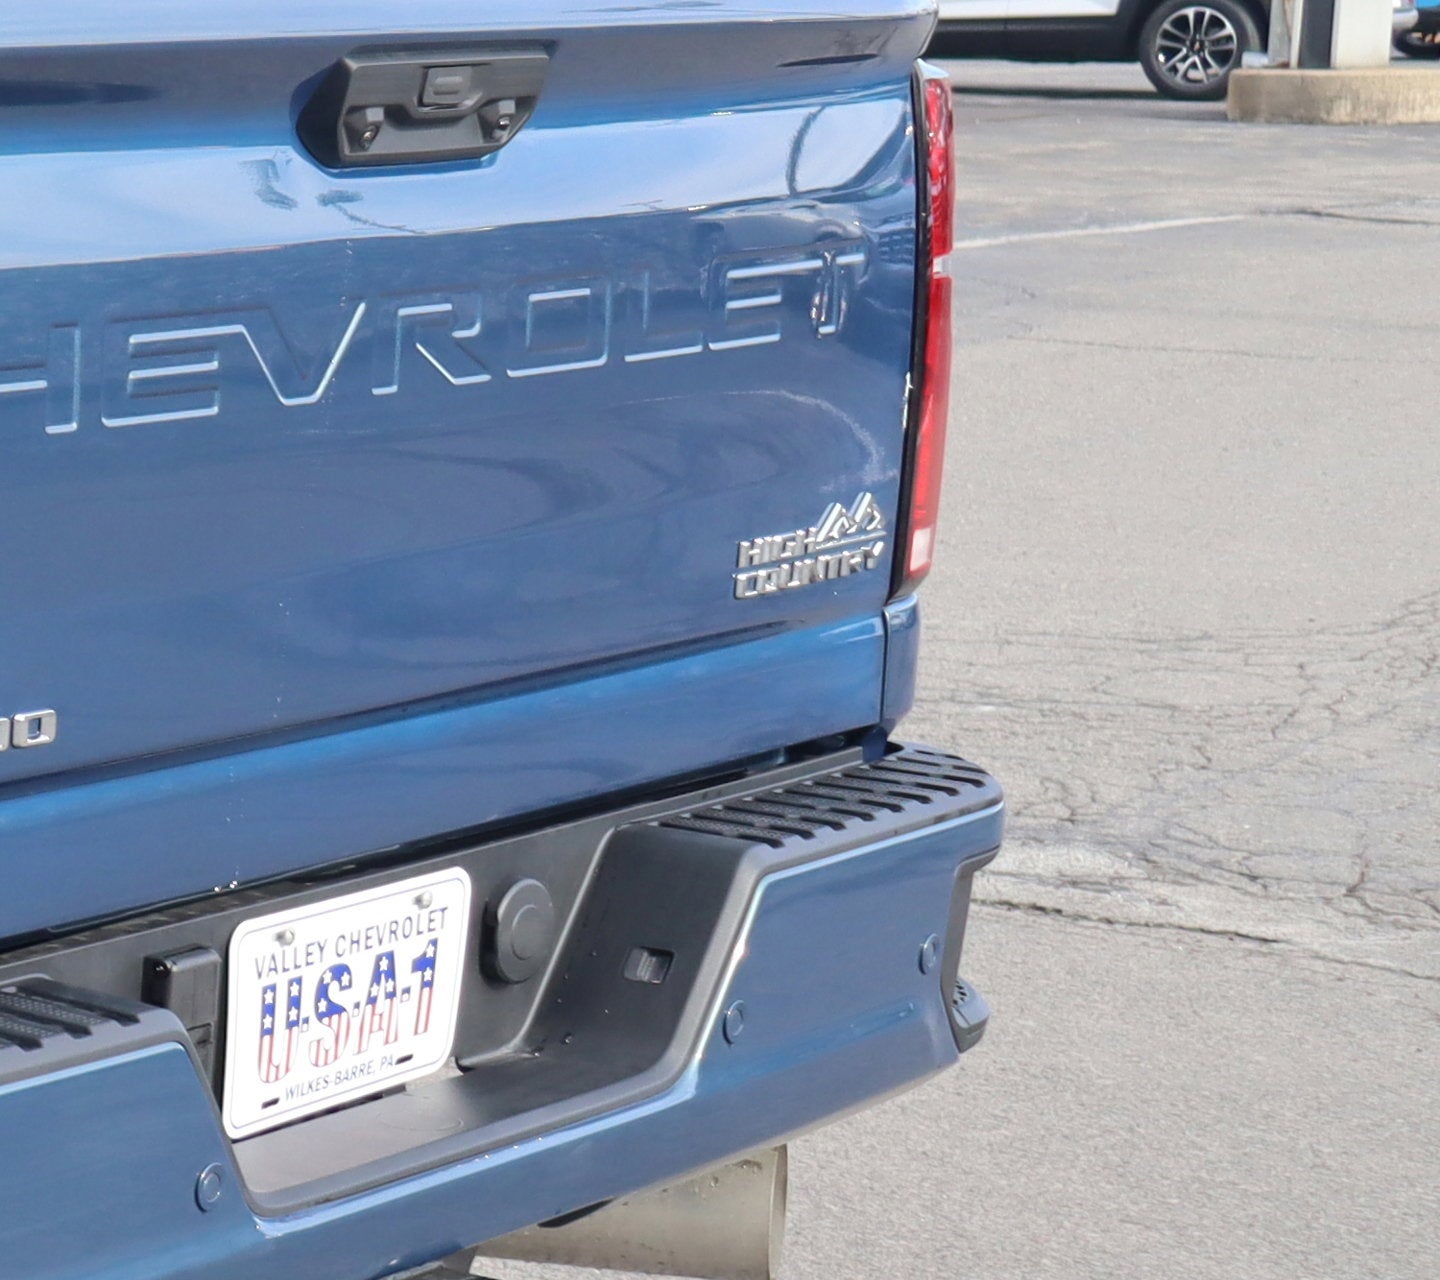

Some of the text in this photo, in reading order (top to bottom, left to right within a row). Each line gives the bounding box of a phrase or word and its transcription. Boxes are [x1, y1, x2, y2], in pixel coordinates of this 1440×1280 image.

[734, 541, 886, 600] COUNTRY
[737, 526, 820, 569] HIGH
[254, 906, 449, 981] VALLEY CHEVROLET
[285, 1054, 395, 1101] WILKES-BARRE, PA
